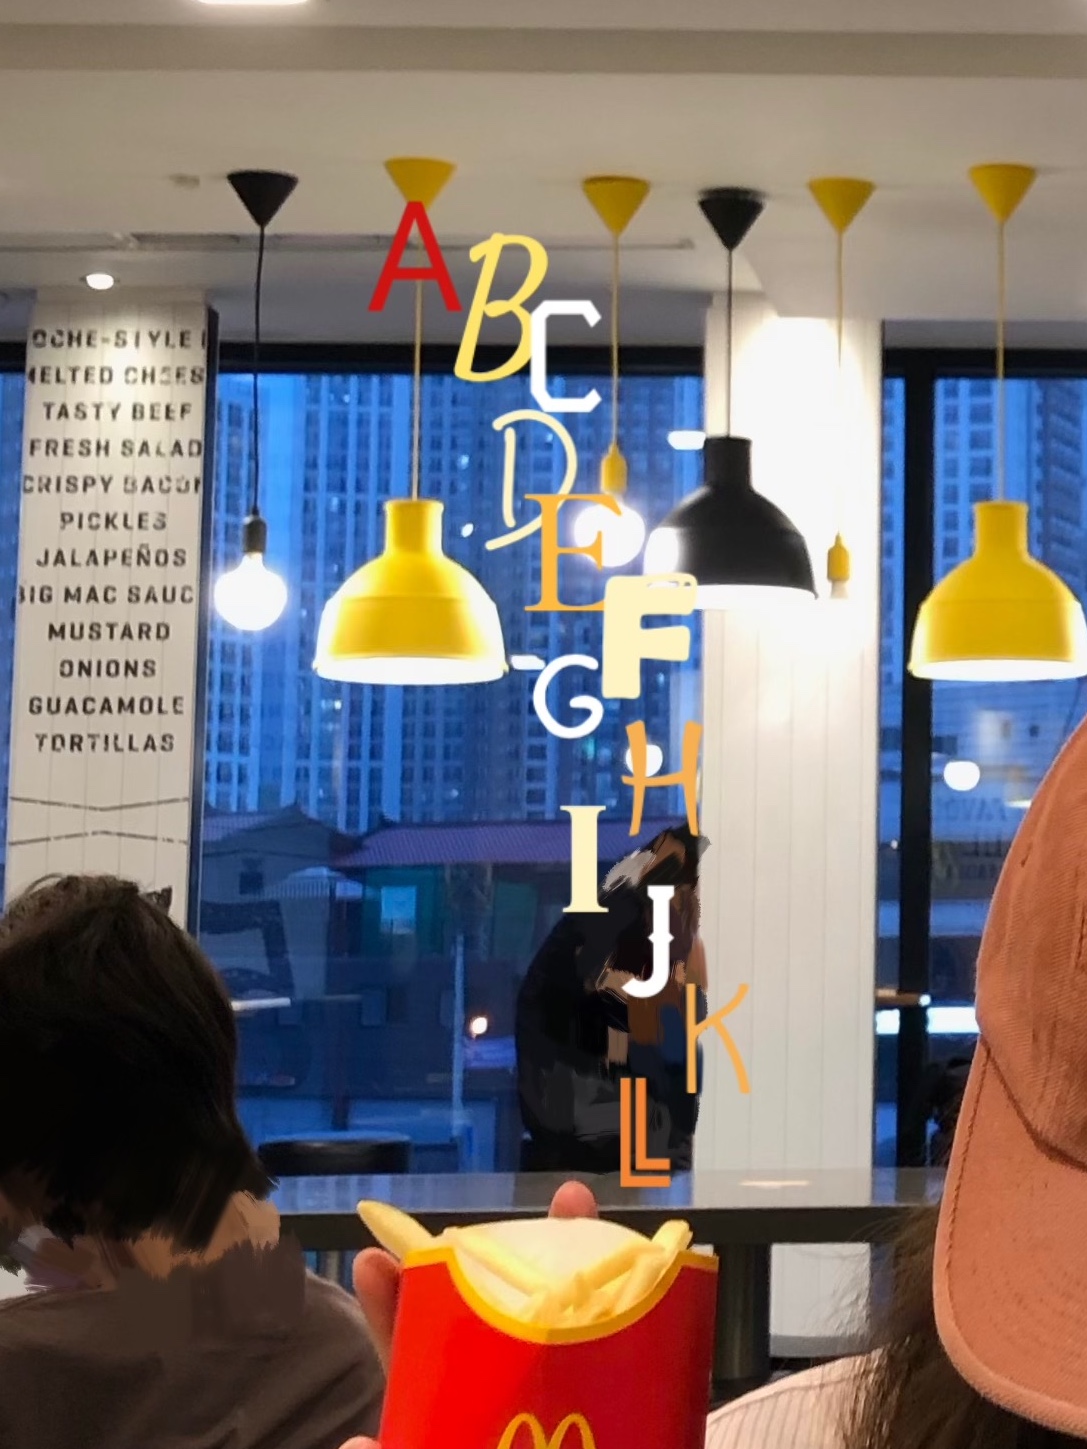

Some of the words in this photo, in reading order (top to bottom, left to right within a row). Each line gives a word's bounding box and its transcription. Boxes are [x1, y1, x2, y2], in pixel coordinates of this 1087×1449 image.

[43, 402, 121, 421] TASTY
[132, 402, 192, 421] BEEF
[29, 438, 110, 458] FRESH
[121, 438, 202, 458] SALAD
[22, 475, 113, 494] CRISPY
[60, 511, 167, 531] PICKLES
[36, 543, 187, 567] JALAPEÑOS
[64, 585, 117, 604] MAC
[127, 585, 194, 604] SAUC
[48, 622, 170, 641] MUSTARD
[59, 659, 157, 678] ONIONS
[28, 696, 184, 715] GUACAMOLE
[35, 733, 175, 752] TORTILLAS
